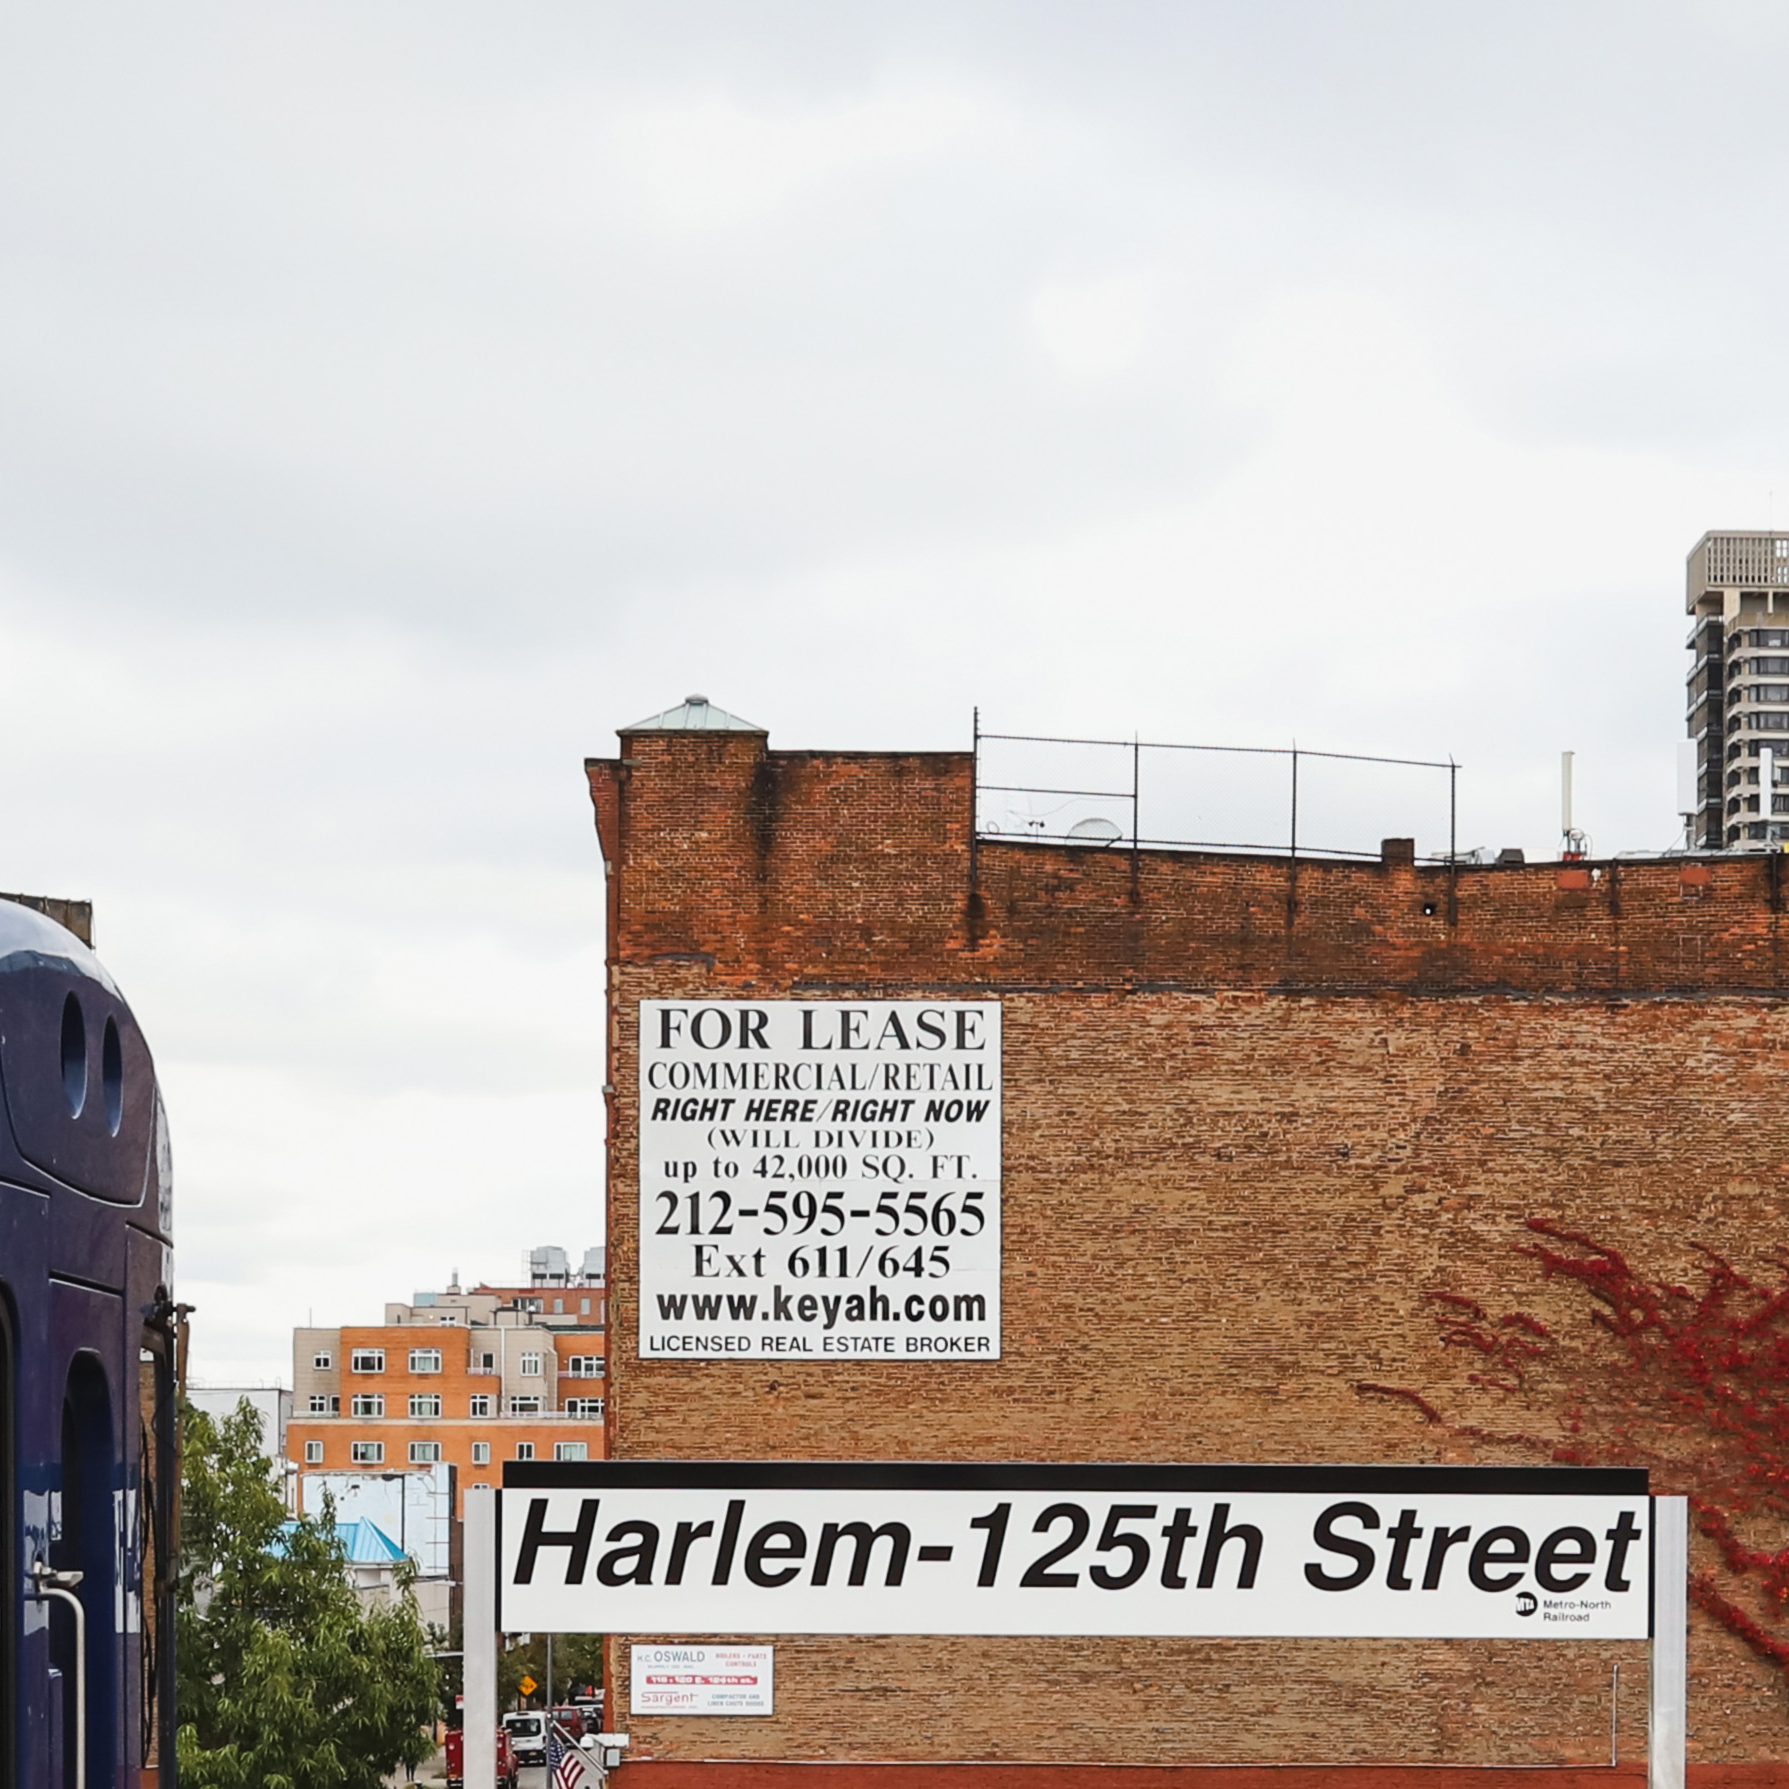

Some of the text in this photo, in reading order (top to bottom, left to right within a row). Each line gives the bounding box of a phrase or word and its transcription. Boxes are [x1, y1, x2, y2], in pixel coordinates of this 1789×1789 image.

[659, 1008, 985, 1050] FOR LEASE
[648, 1062, 992, 1090] COMMERCIAL/RETAIL
[651, 1098, 990, 1122] RIGHT HERE/RIGHT NOW
[707, 1127, 935, 1151] (WILL DIVIDE)
[665, 1155, 976, 1183] up to 42,000 SQ. FT.
[656, 1191, 984, 1236] 212-595-5565
[694, 1245, 949, 1278] Ext 611/645
[657, 1285, 985, 1330] www.keyah.com
[650, 1336, 989, 1352] LICENSED REAL ESTATE BROKER
[514, 1499, 1641, 1592] Harlem-125th Street
[1543, 1600, 1611, 1610] Metro-North
[1543, 1612, 1590, 1622] Railroad
[654, 1650, 706, 1663] OSWALD
[641, 1691, 699, 1706] Sargent
